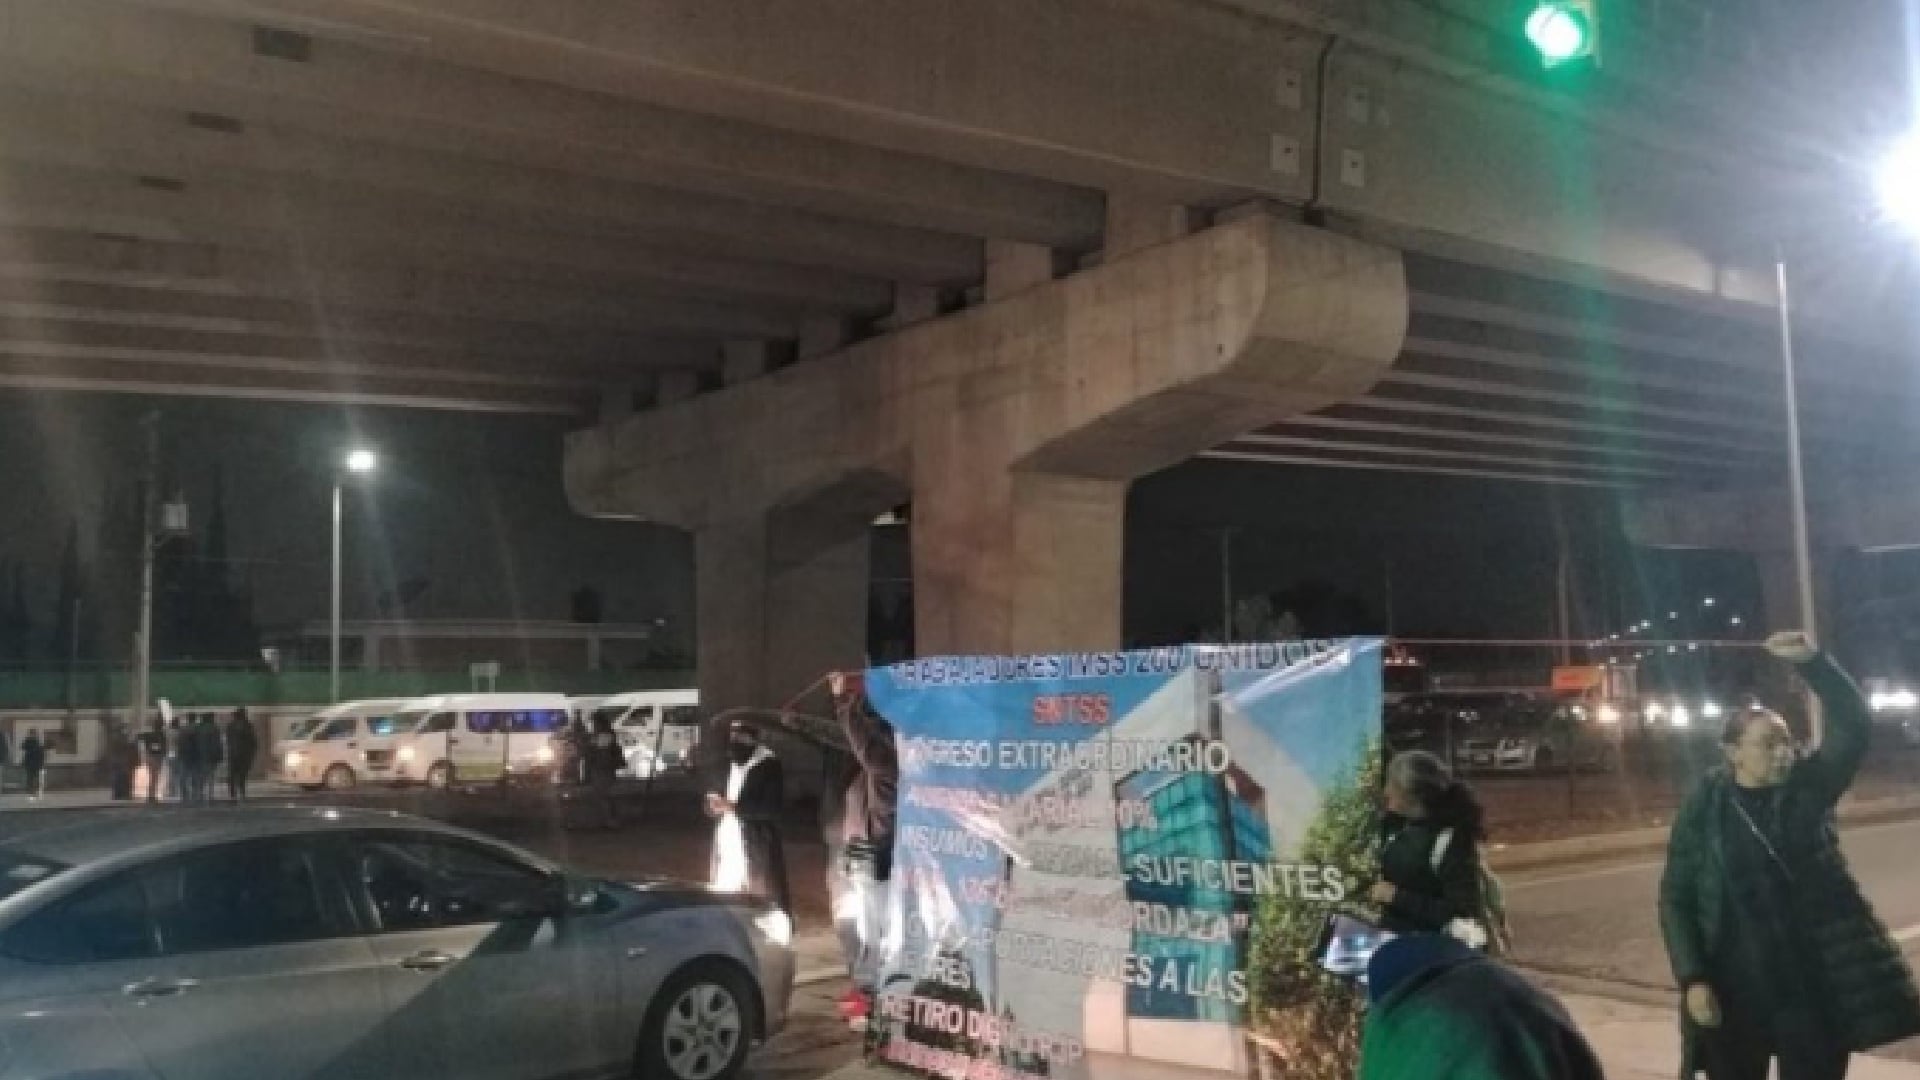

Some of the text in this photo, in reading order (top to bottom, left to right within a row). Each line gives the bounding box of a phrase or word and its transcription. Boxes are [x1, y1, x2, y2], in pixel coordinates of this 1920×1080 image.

[1033, 695, 1109, 724] SNTSS
[1000, 740, 1229, 772] EXTRAORDINARIO
[1136, 854, 1345, 902] SUFICIENTES
[1094, 895, 1249, 943] ORDAZA"
[970, 929, 1152, 986] PORTACIONES
[1159, 958, 1178, 992] A
[1188, 964, 1249, 1005] LAS
[879, 993, 962, 1034] RETIRO
